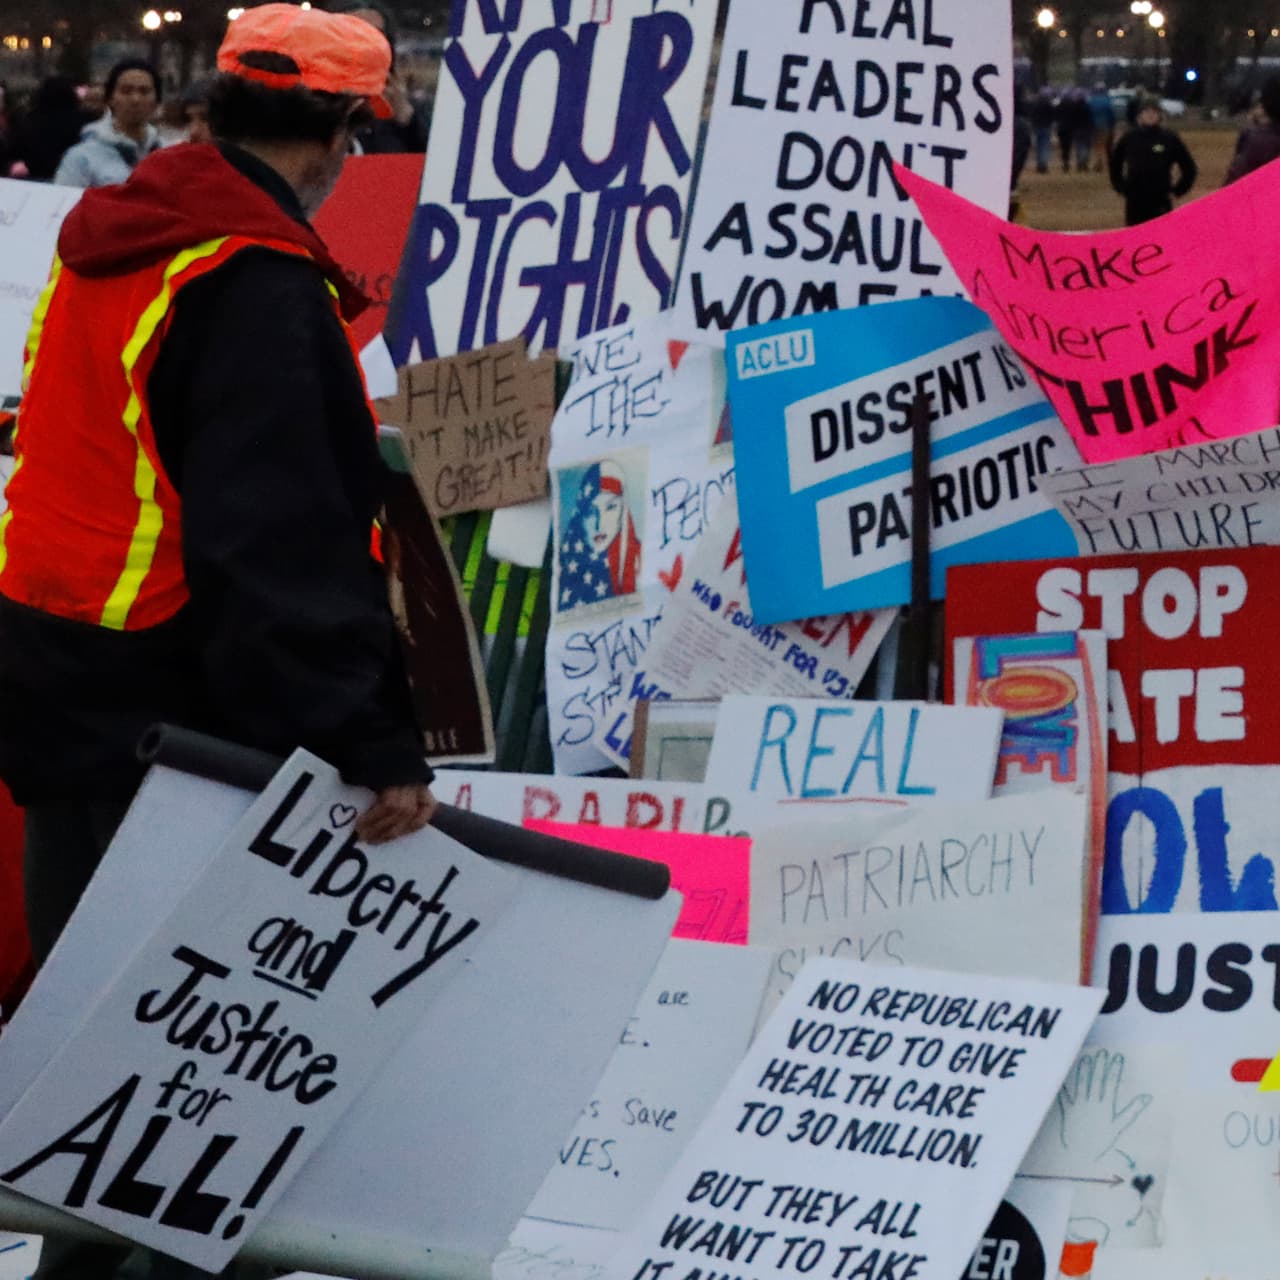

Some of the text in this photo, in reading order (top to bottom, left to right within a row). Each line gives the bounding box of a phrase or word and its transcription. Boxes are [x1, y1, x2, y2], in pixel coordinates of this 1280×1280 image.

[443, 10, 694, 204] YOUR
[730, 50, 1003, 134] LEADERS
[776, 132, 967, 202] DON'T
[703, 202, 943, 276] ASSAUL
[998, 231, 1173, 292] Make
[403, 184, 682, 366] RIGHTS
[689, 272, 963, 331] WOM
[972, 268, 1249, 363] America
[406, 349, 518, 424] HATE
[572, 327, 642, 384] WE
[740, 334, 809, 375] ACLU
[1015, 298, 1261, 438] THINK
[463, 409, 529, 459] MAKE
[564, 369, 672, 438] THE
[810, 342, 1028, 464] DISSENT IS
[847, 434, 1057, 558] PARIOTIC
[1061, 491, 1123, 518] MY
[1078, 501, 1268, 554] FUTURE
[1035, 565, 1248, 641] STOP
[783, 642, 820, 681] FOR
[1106, 666, 1246, 746] ATE
[750, 702, 937, 798] REAL
[246, 771, 481, 1009] Liberty
[778, 827, 1046, 925] PATRIARCHY
[246, 916, 358, 993] and
[134, 945, 338, 1106] Justice
[656, 989, 690, 1007] are
[806, 979, 1063, 1040] NO REPUBLICAN
[786, 1018, 1028, 1080] VOTED TO GIVE
[152, 1059, 233, 1127] for
[756, 1057, 987, 1120] HEALTH CARE
[0, 1073, 305, 1241] ALL!
[558, 1135, 620, 1178] VES.
[734, 1101, 984, 1170] TO 30 MILLION.
[685, 1169, 923, 1240] BUT THEY ALL
[657, 1212, 776, 1265] WANT
[773, 1231, 826, 1274] TO
[831, 1245, 928, 1280] TAKE
